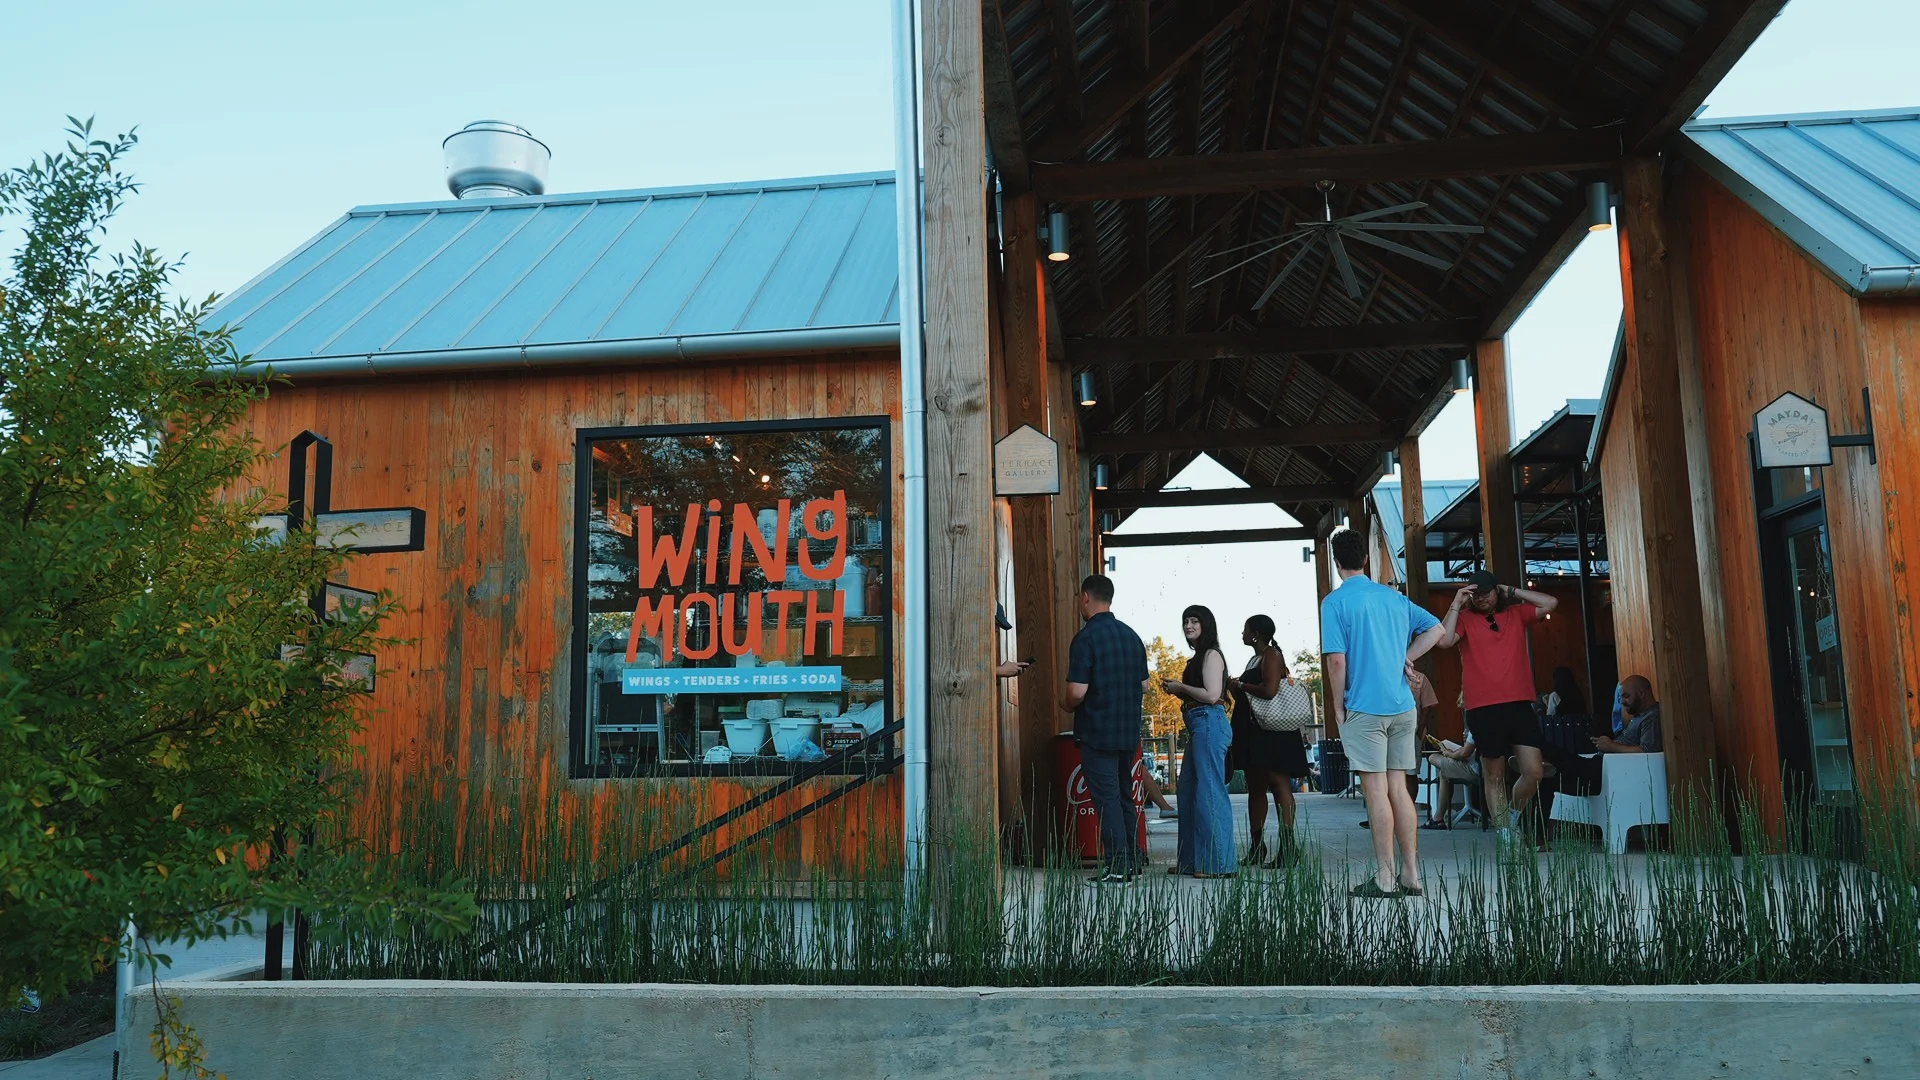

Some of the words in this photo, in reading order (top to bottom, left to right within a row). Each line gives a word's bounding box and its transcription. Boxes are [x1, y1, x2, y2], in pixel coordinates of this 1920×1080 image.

[1767, 409, 1817, 428] MAYDAY
[1002, 459, 1053, 469] TERRACE
[322, 521, 405, 536] TERACE
[625, 590, 845, 663] MOUTH
[628, 676, 671, 687] WINGS
[682, 675, 740, 686] TENDERS
[752, 674, 788, 685] FRIES
[800, 674, 836, 685] SODA
